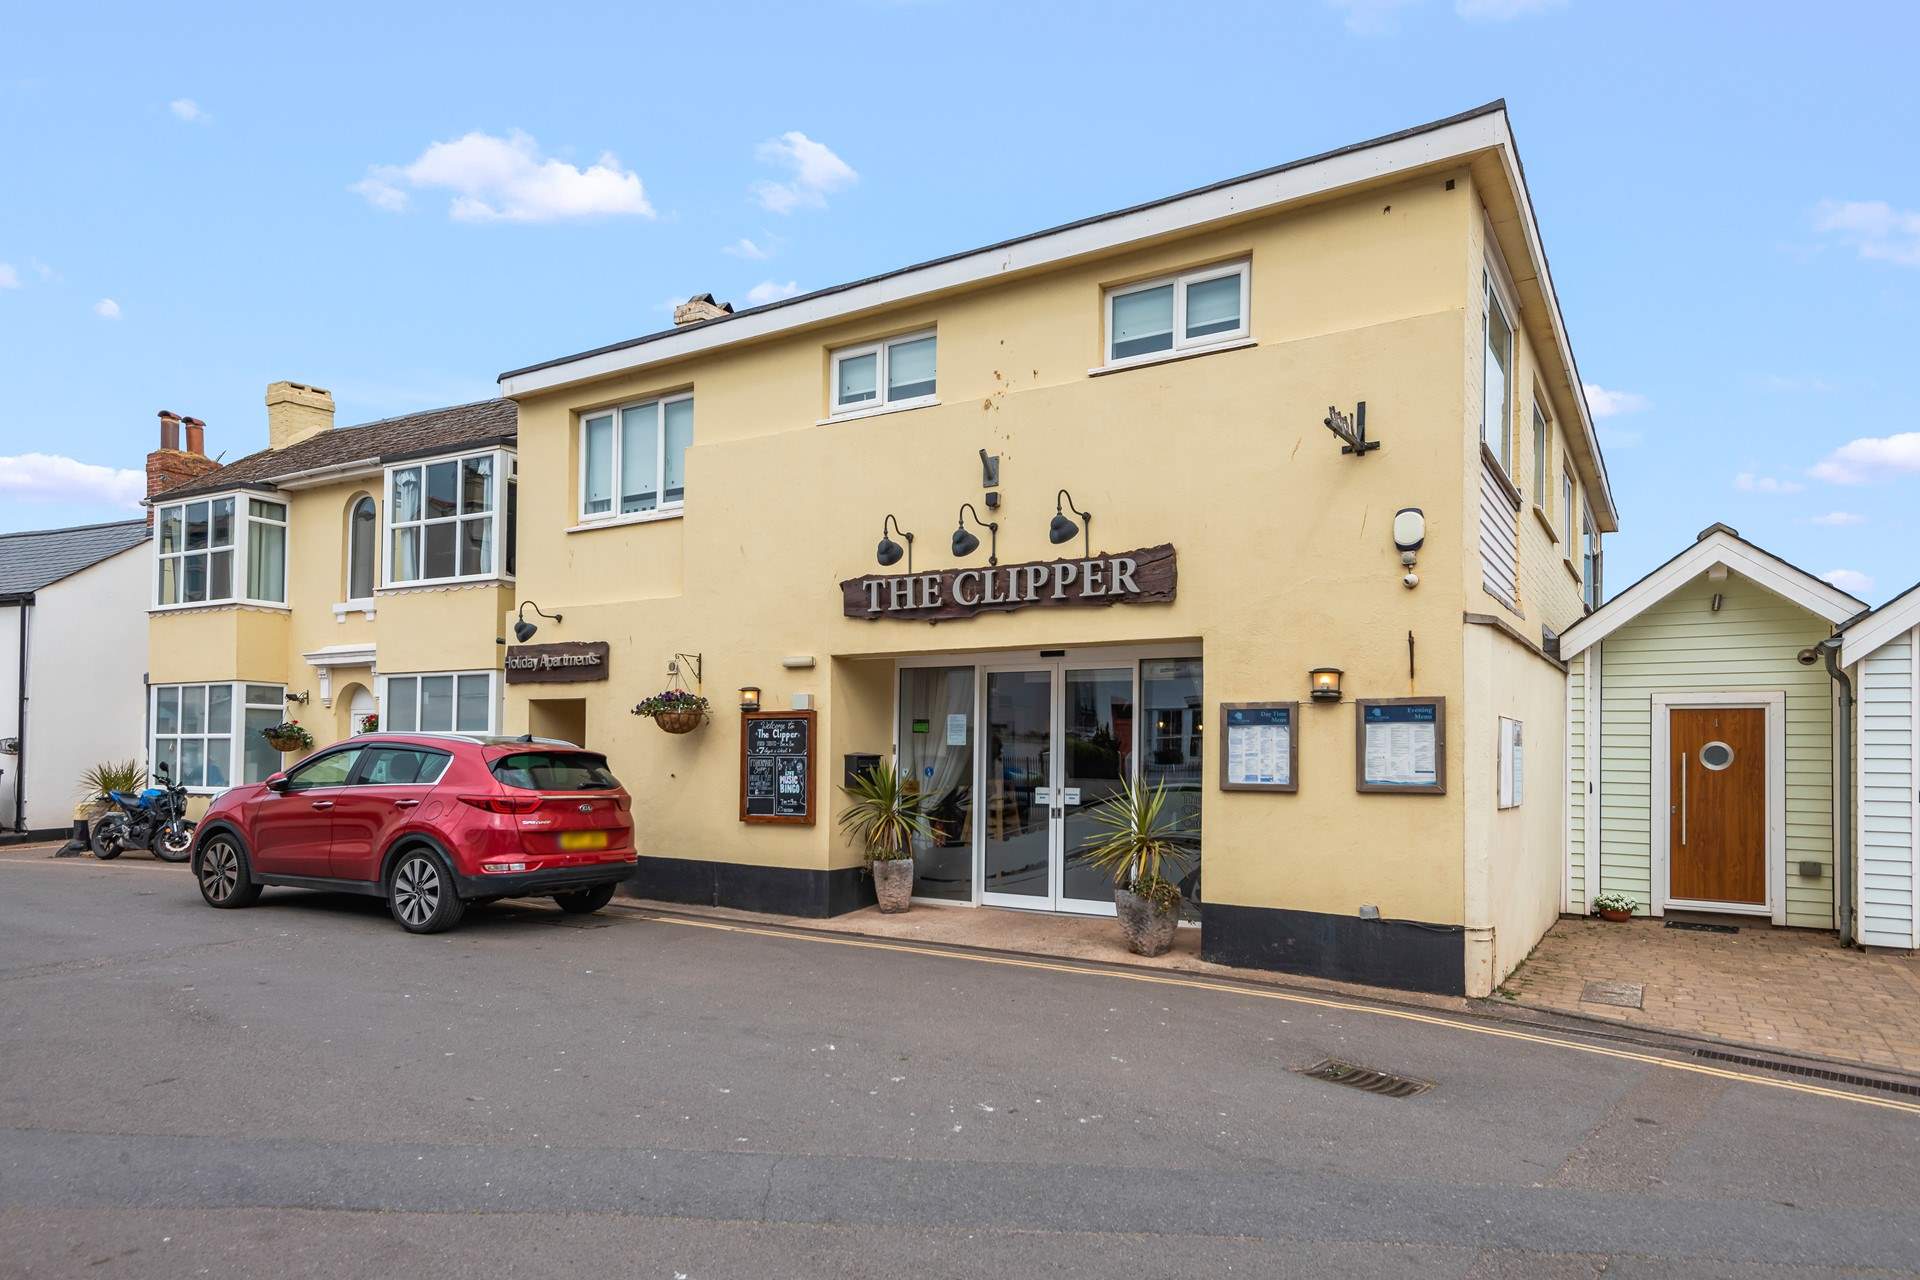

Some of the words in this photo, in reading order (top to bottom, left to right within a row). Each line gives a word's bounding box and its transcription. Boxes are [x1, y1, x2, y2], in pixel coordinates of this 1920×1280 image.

[862, 574, 943, 612] THE
[952, 557, 1141, 606] CLIPPER
[540, 652, 600, 671] Apartments
[757, 729, 769, 738] The
[772, 729, 798, 742] Clipper
[780, 776, 798, 784] MUSIC
[780, 784, 800, 793] BINGO
